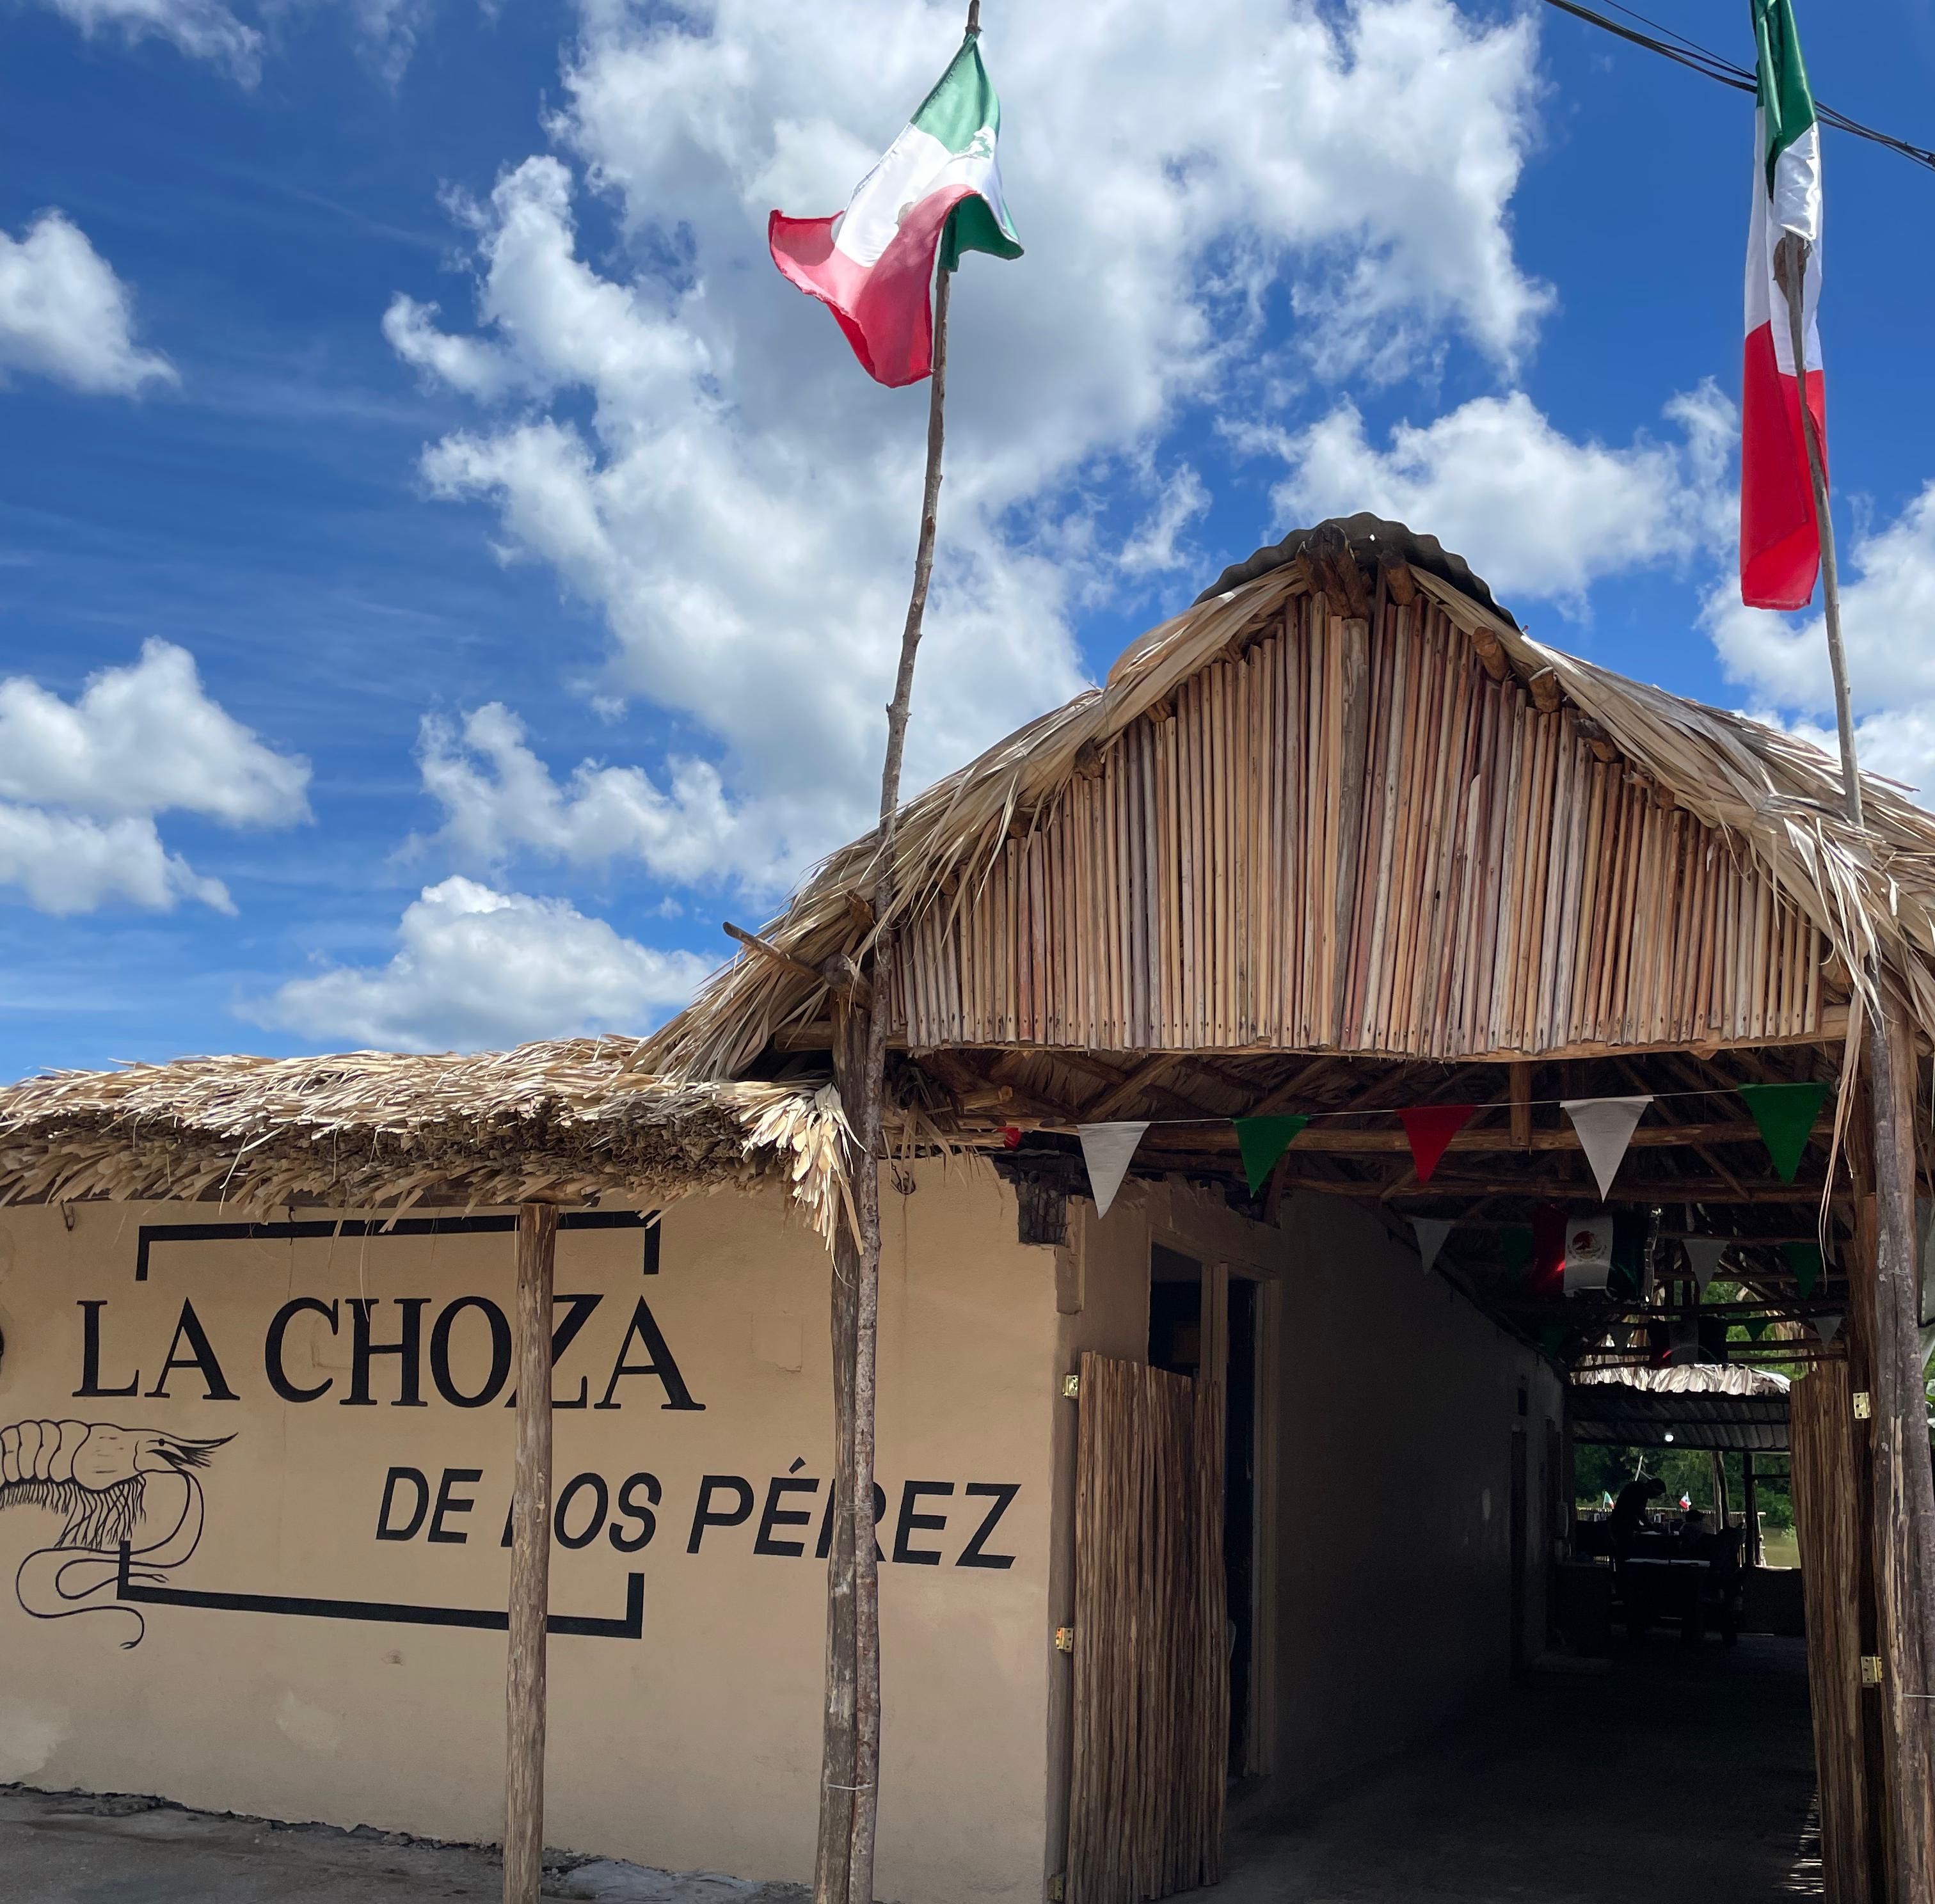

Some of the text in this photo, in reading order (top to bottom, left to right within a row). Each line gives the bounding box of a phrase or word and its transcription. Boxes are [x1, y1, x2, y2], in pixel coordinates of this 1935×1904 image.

[72, 1294, 706, 1411] LA CHOZA
[376, 1466, 484, 1544] DE
[500, 1472, 662, 1553] OS
